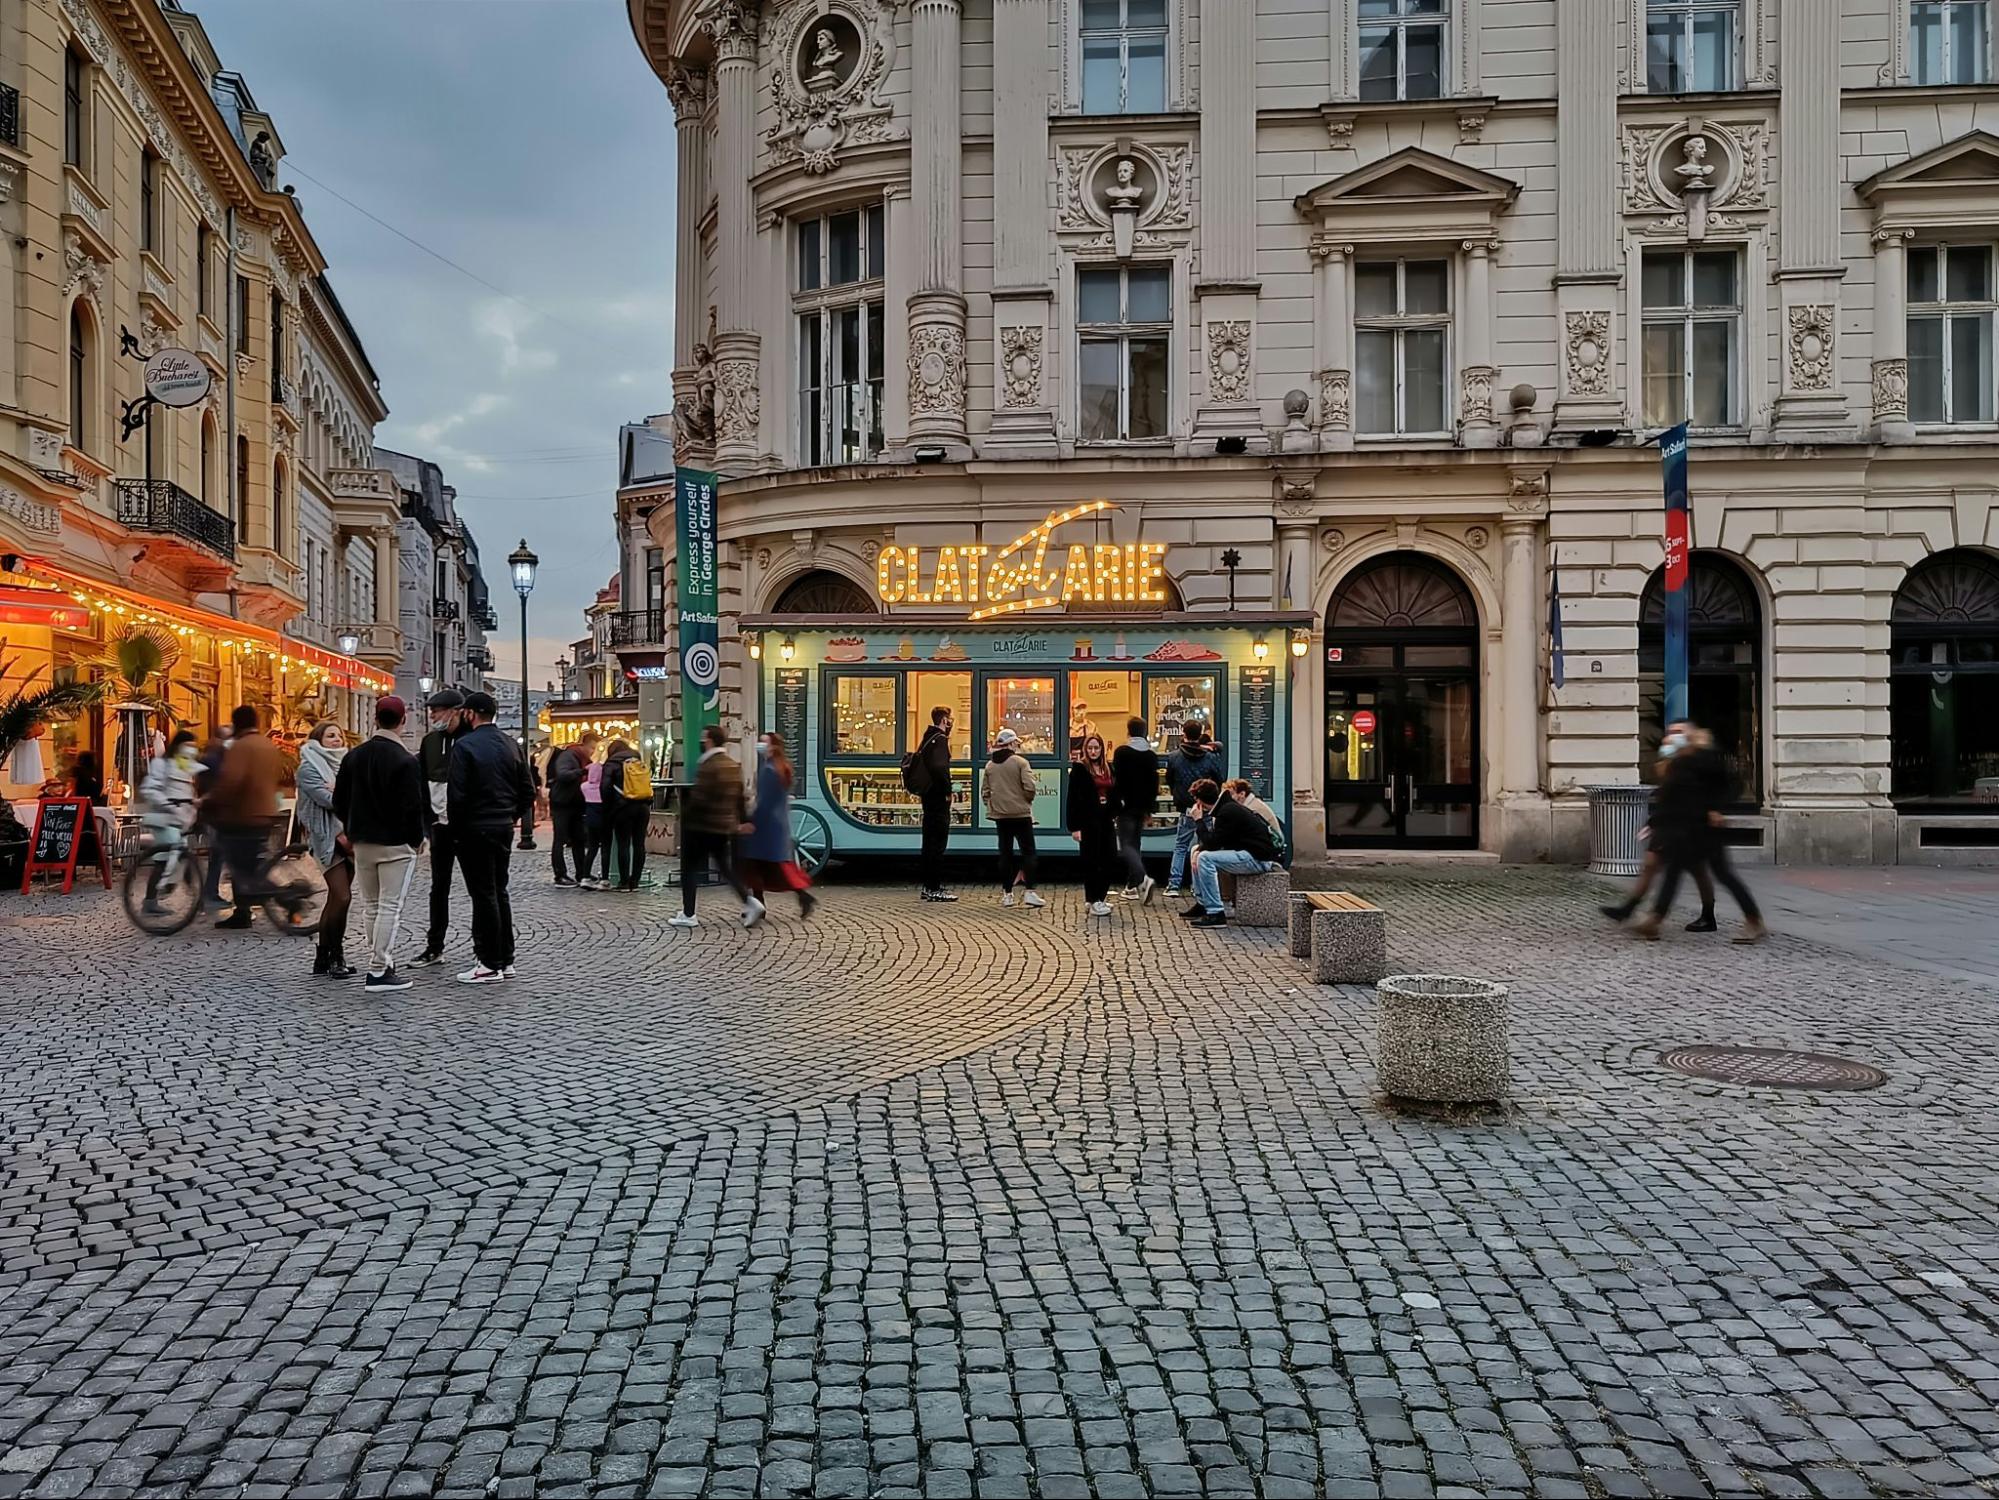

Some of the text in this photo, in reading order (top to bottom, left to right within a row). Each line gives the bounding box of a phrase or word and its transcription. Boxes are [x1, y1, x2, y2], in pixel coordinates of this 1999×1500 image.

[685, 481, 700, 595] Express yourself
[700, 484, 714, 596] in George Circles
[681, 610, 718, 624] Art Safar
[1155, 694, 1207, 708] Collect your
